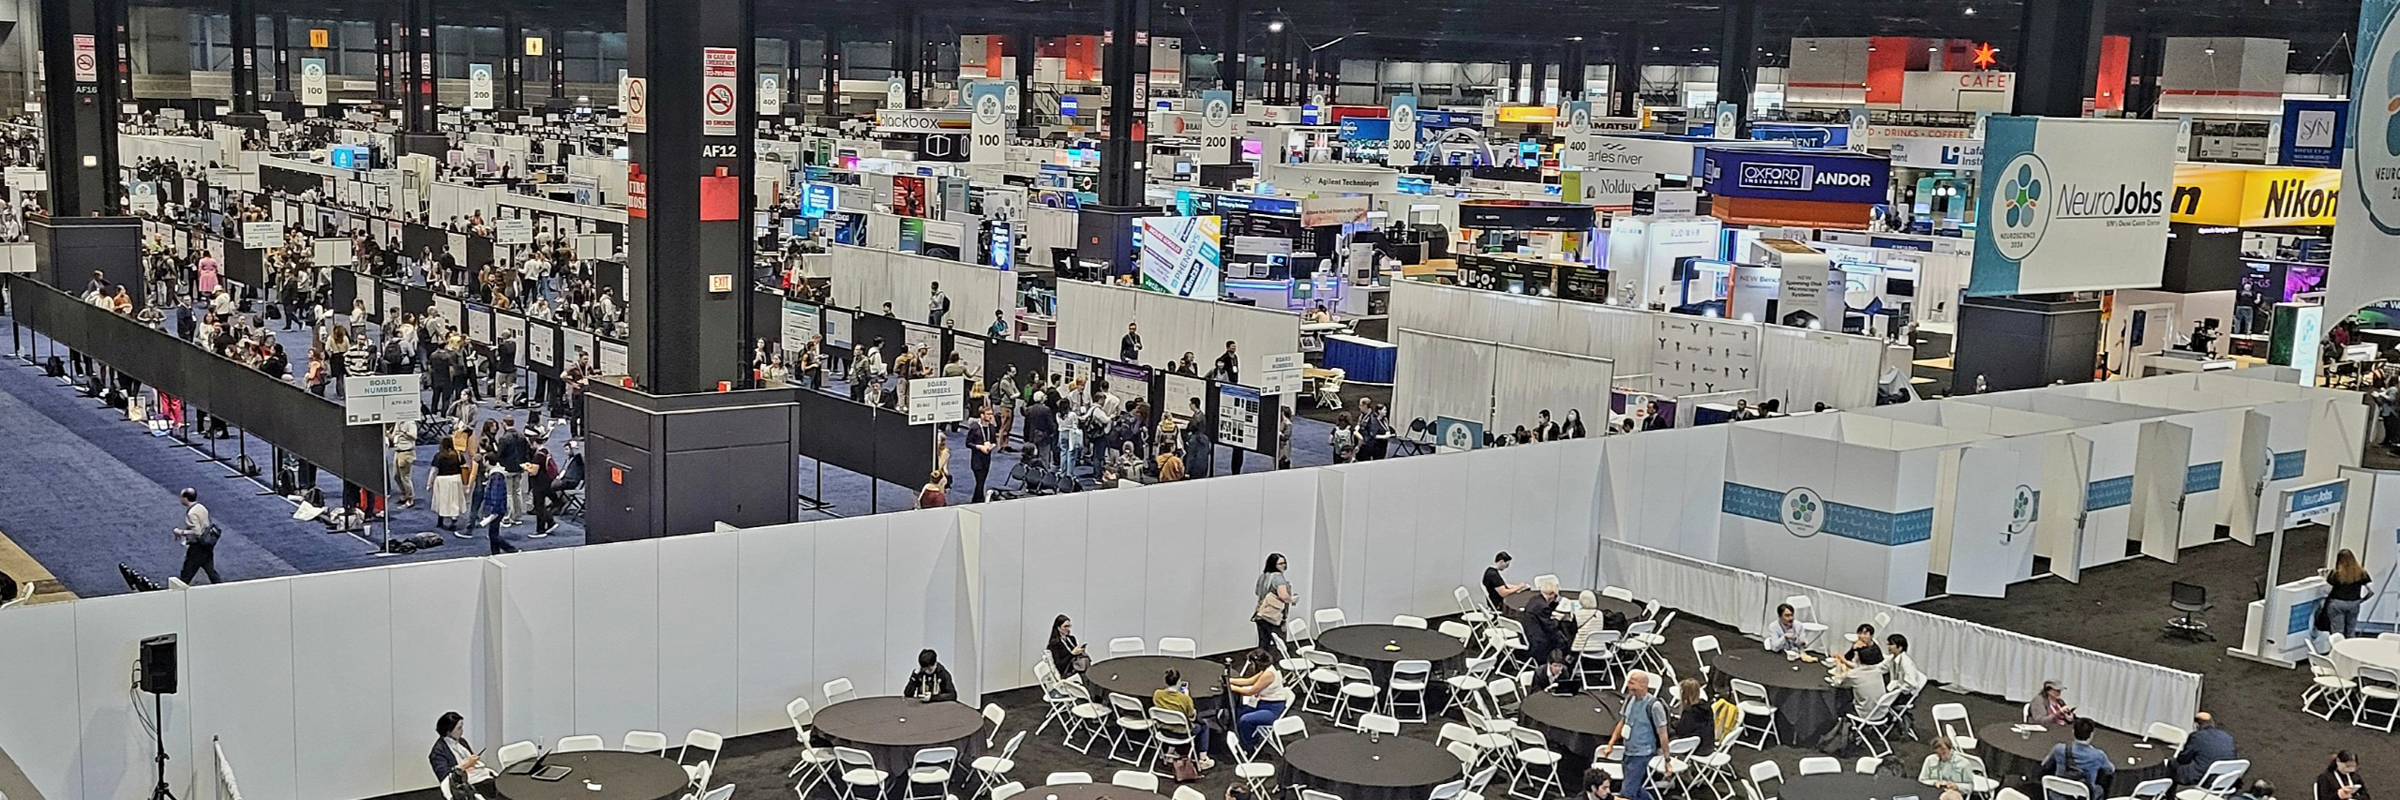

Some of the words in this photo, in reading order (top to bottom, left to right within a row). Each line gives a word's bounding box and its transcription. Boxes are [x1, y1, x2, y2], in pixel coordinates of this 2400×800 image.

[76, 86, 98, 94] AF16
[880, 114, 939, 129] blackbox
[1884, 128, 1919, 138] DRINKS
[1928, 130, 1966, 138] COFFEE
[978, 134, 1000, 146] 100
[1206, 136, 1227, 147] 200
[1393, 139, 1411, 150] 300
[702, 145, 737, 158] AF12
[1569, 142, 1587, 151] 400
[1616, 152, 1644, 165] river
[1744, 166, 1800, 181] OXFORD
[1814, 172, 1872, 187] ANDOR
[628, 181, 646, 194] FIRE
[1318, 178, 1341, 187] Agilent
[1342, 179, 1380, 188] Technologies
[1600, 179, 1636, 194] Noldus
[628, 196, 646, 209] HOSE
[2056, 181, 2163, 216] NeuroJobs
[2263, 178, 2340, 218] Nikon
[1174, 233, 1200, 280] PHENOSYS
[714, 276, 729, 288] EXIT
[369, 378, 397, 386] BOARD
[364, 386, 403, 394] NUMBERS
[922, 387, 951, 395] NUMBERS
